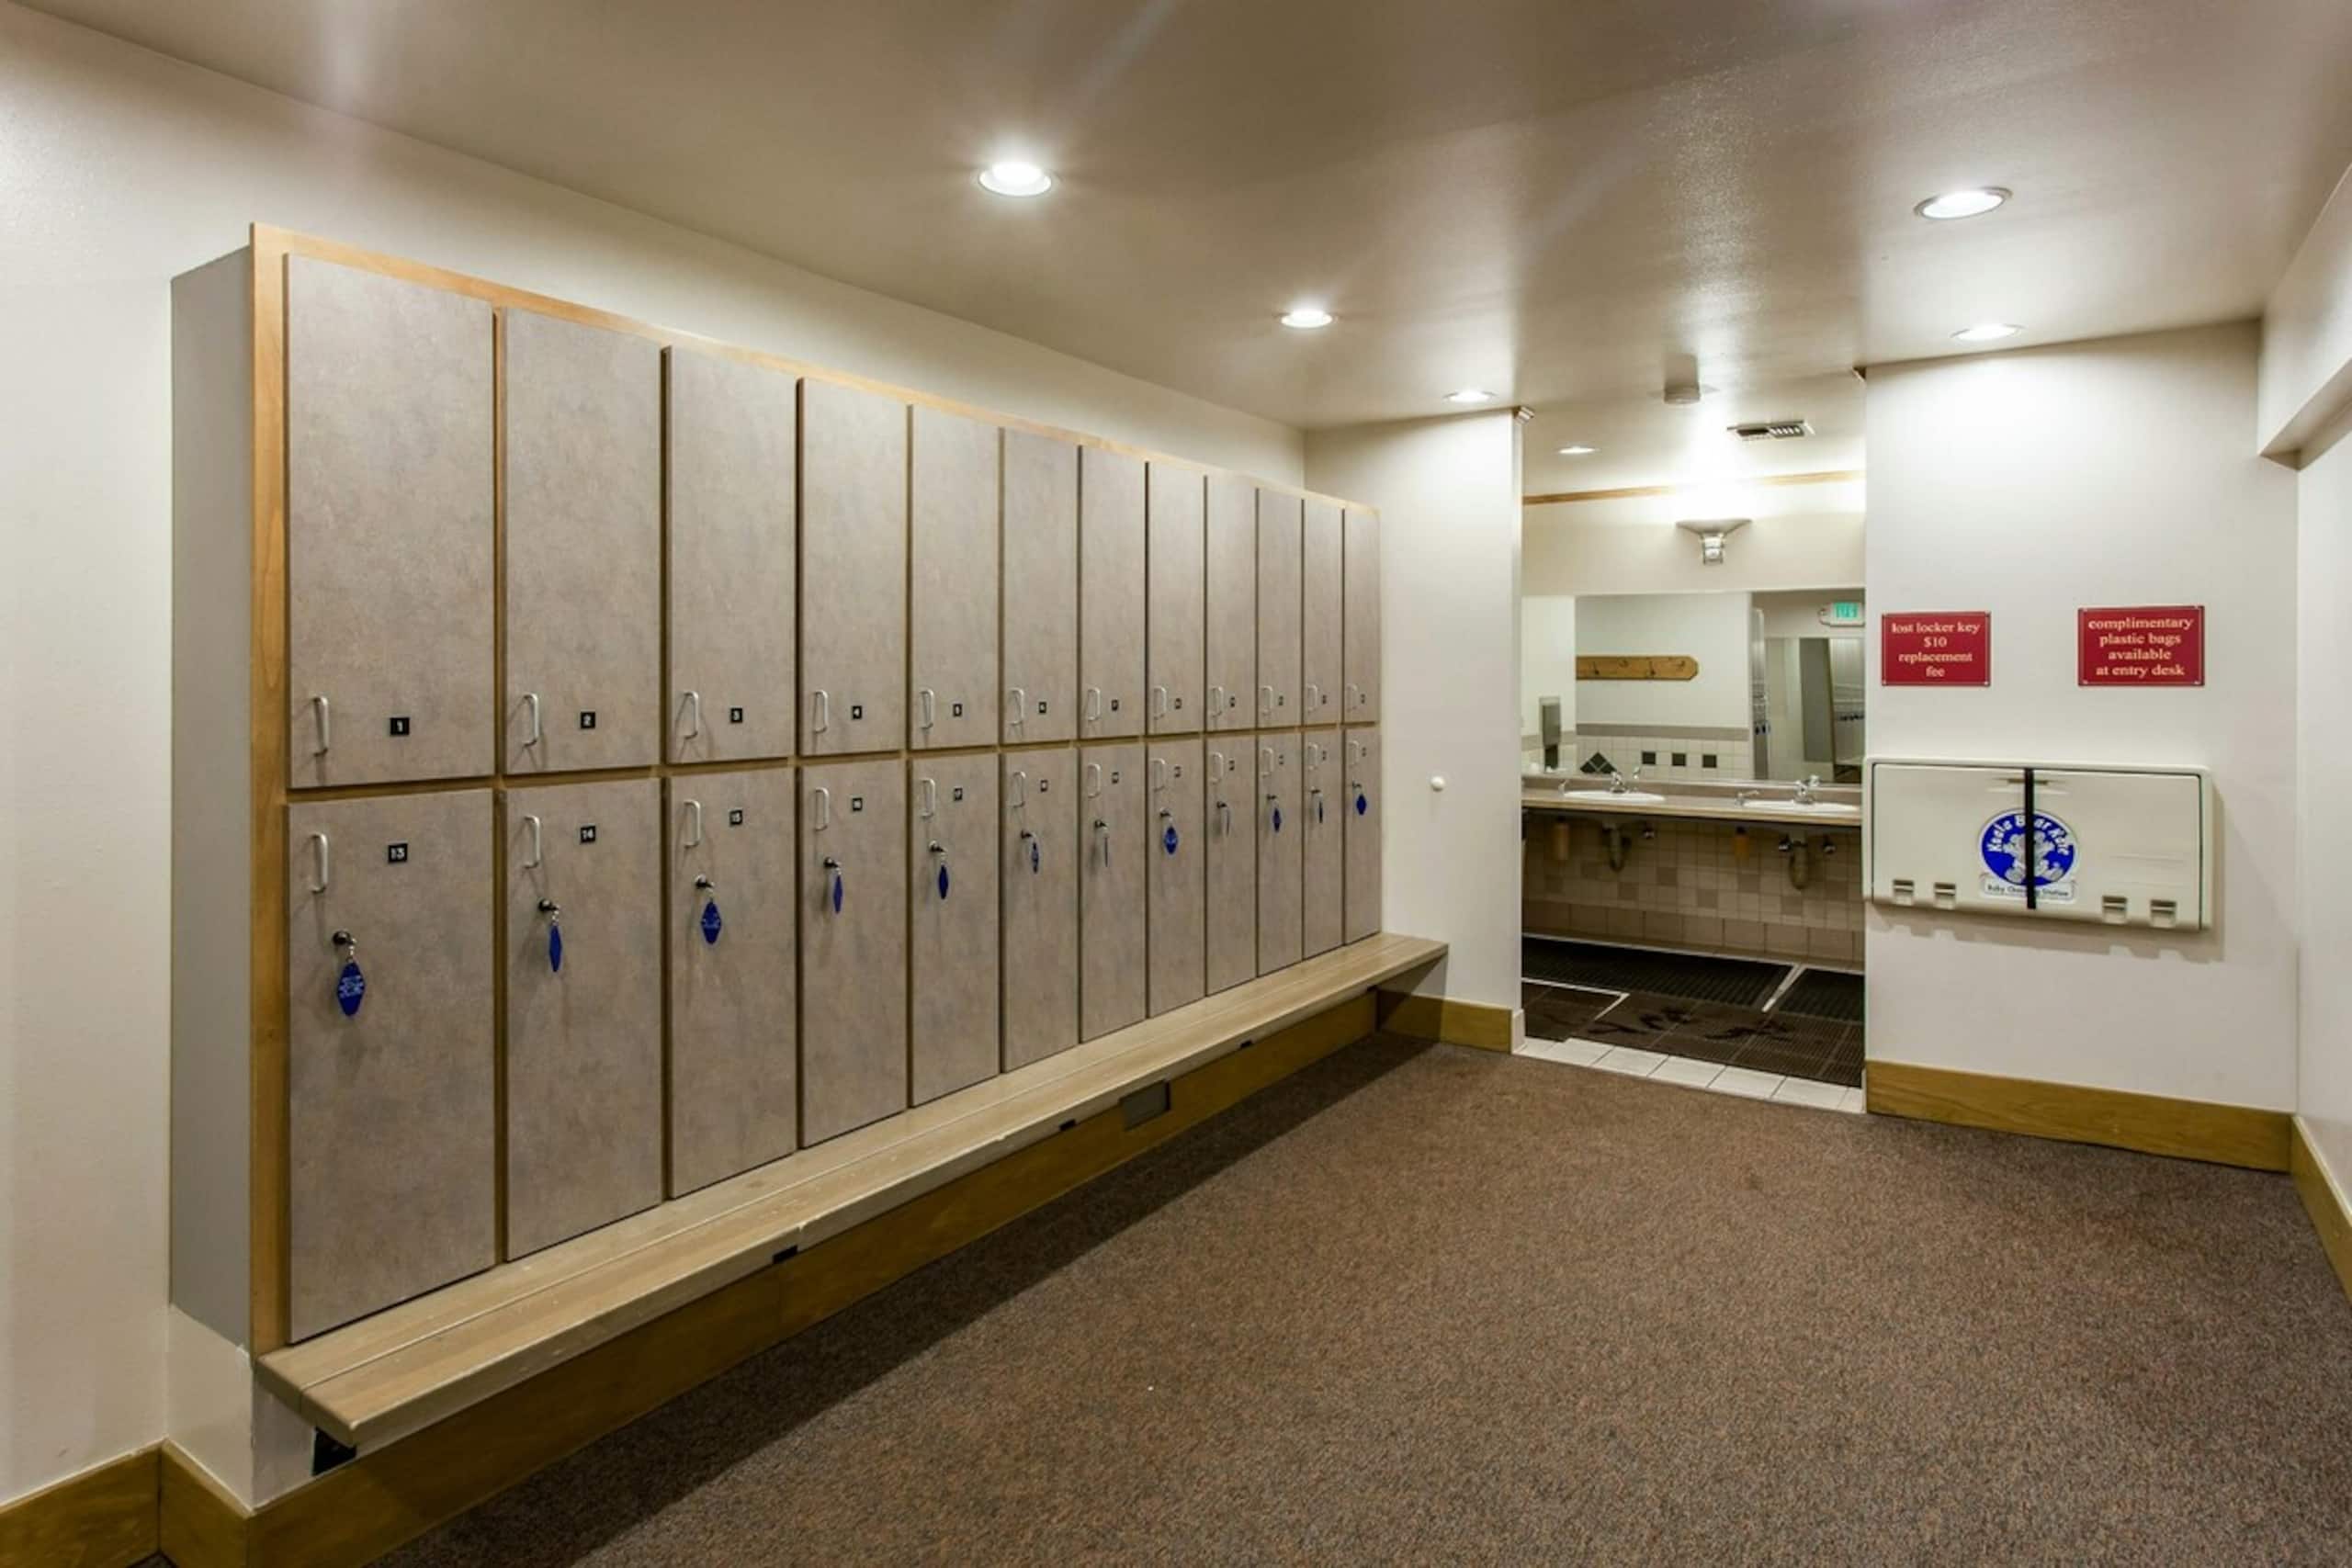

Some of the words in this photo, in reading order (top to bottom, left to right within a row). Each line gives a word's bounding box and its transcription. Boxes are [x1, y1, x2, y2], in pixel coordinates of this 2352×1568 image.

[1892, 623, 1914, 633] lost
[1917, 622, 1954, 633] locker
[1957, 621, 1981, 635] key
[2088, 617, 2194, 631] complimentary
[1924, 636, 1948, 648] $10
[2099, 633, 2144, 648] plastic
[2148, 632, 2181, 647] bags
[1898, 652, 1973, 664] replacement
[2109, 649, 2171, 660] available
[1926, 666, 1946, 677] fee
[2096, 666, 2109, 675] at
[2112, 666, 2147, 678] entry
[2151, 664, 2185, 676] desk
[2015, 815, 2052, 830] Bar
